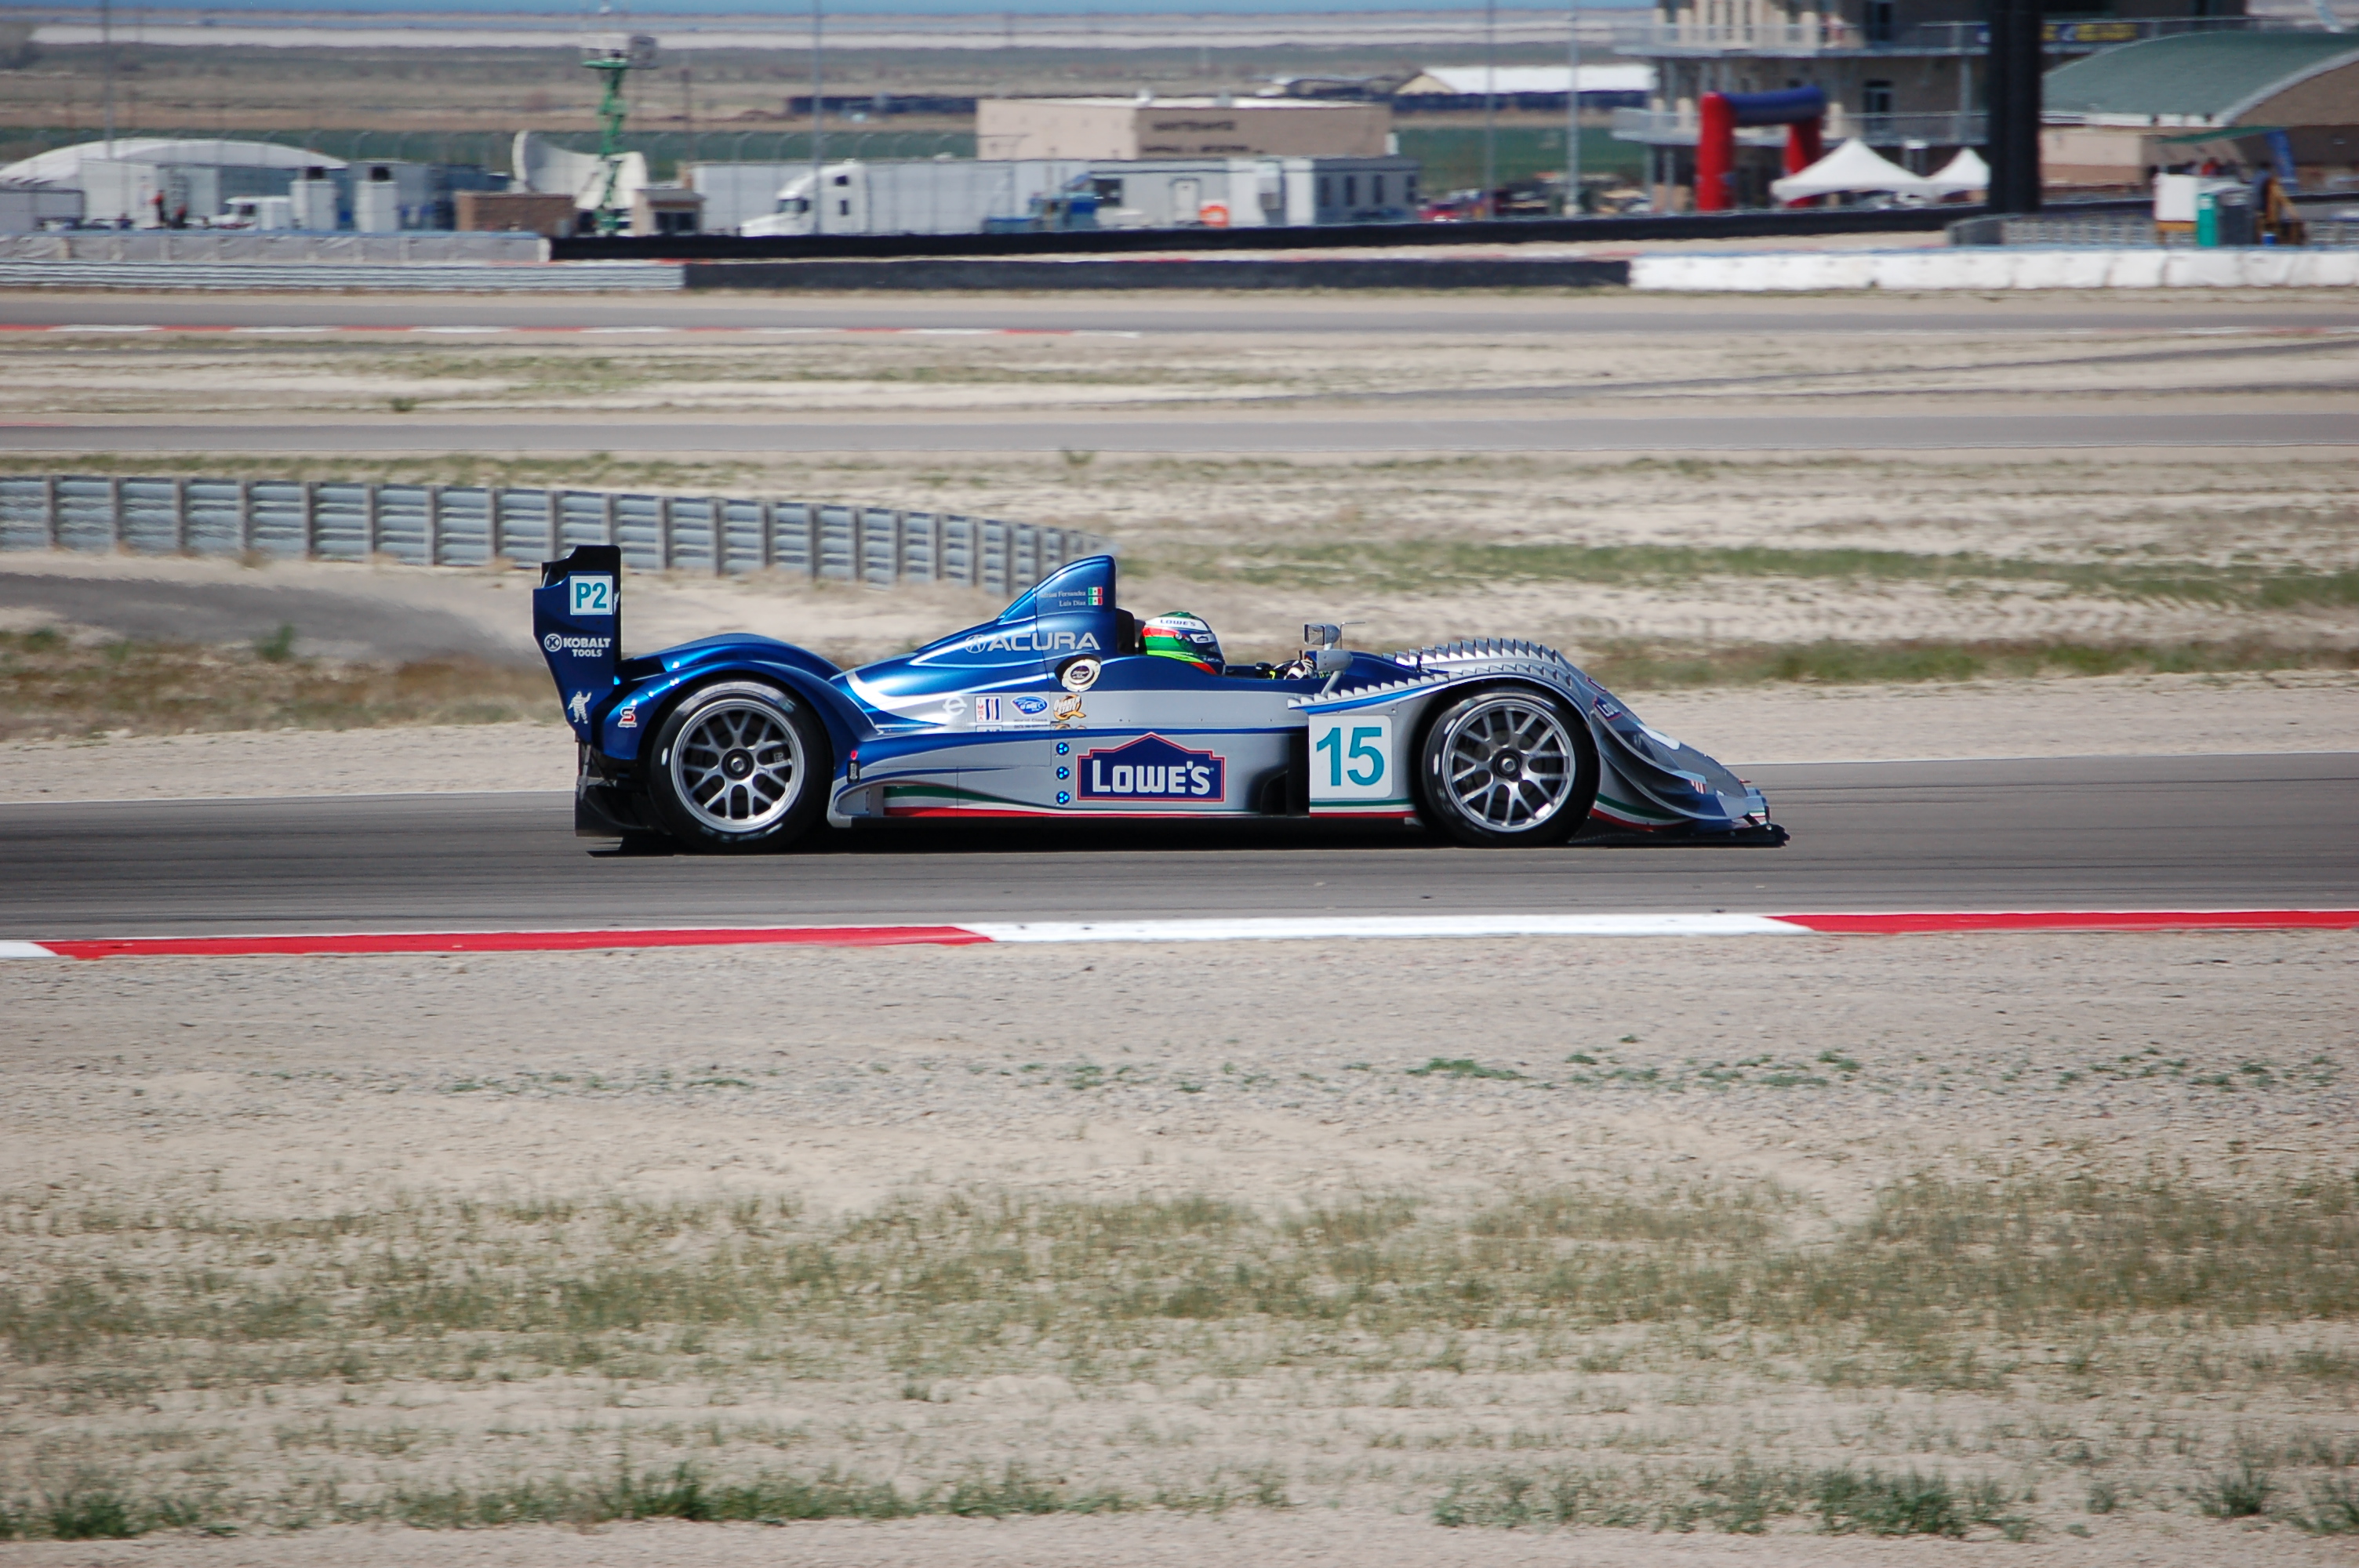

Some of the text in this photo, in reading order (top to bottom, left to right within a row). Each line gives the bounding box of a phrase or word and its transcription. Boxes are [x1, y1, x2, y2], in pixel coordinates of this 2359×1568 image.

[576, 582, 607, 608] P2
[563, 637, 611, 648] KOBALT
[987, 632, 1101, 652] ACURA
[1317, 727, 1384, 786] 15
[1092, 760, 1210, 795] LOWE'S
